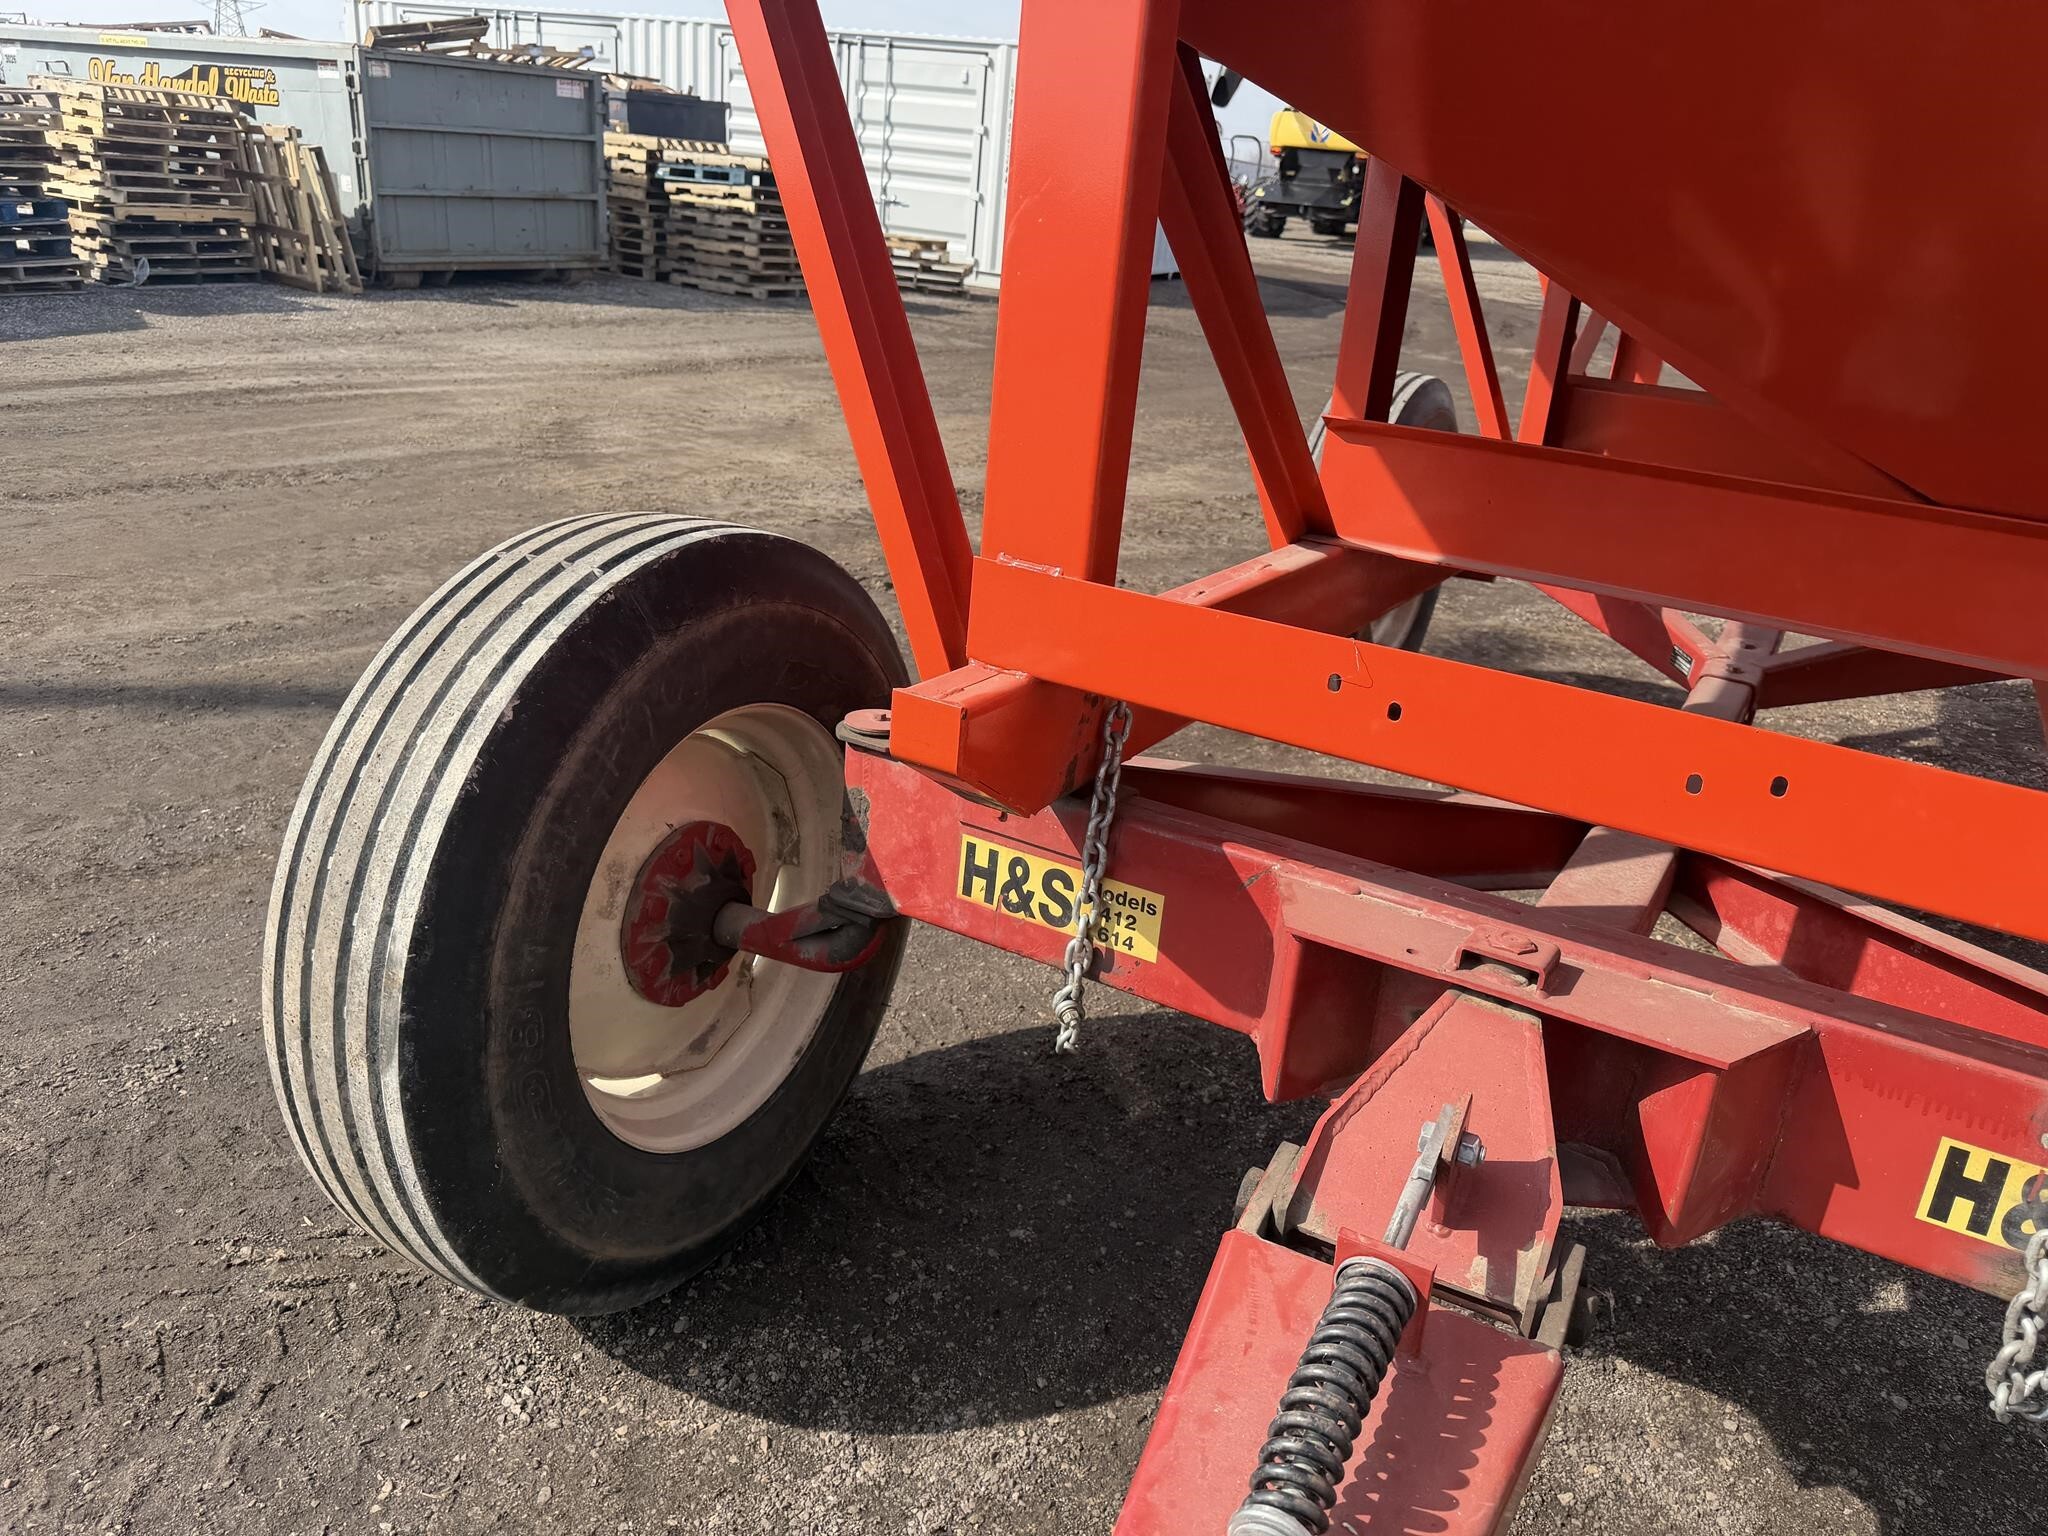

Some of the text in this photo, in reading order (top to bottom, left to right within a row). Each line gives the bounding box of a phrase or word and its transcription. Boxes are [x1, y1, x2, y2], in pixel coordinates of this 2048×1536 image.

[224, 67, 276, 84] RECYCLING &
[224, 75, 280, 107] Waste
[962, 841, 1075, 928] H&S
[1098, 883, 1157, 916] odels
[1100, 907, 1137, 931] 412
[1097, 927, 1134, 951] 614
